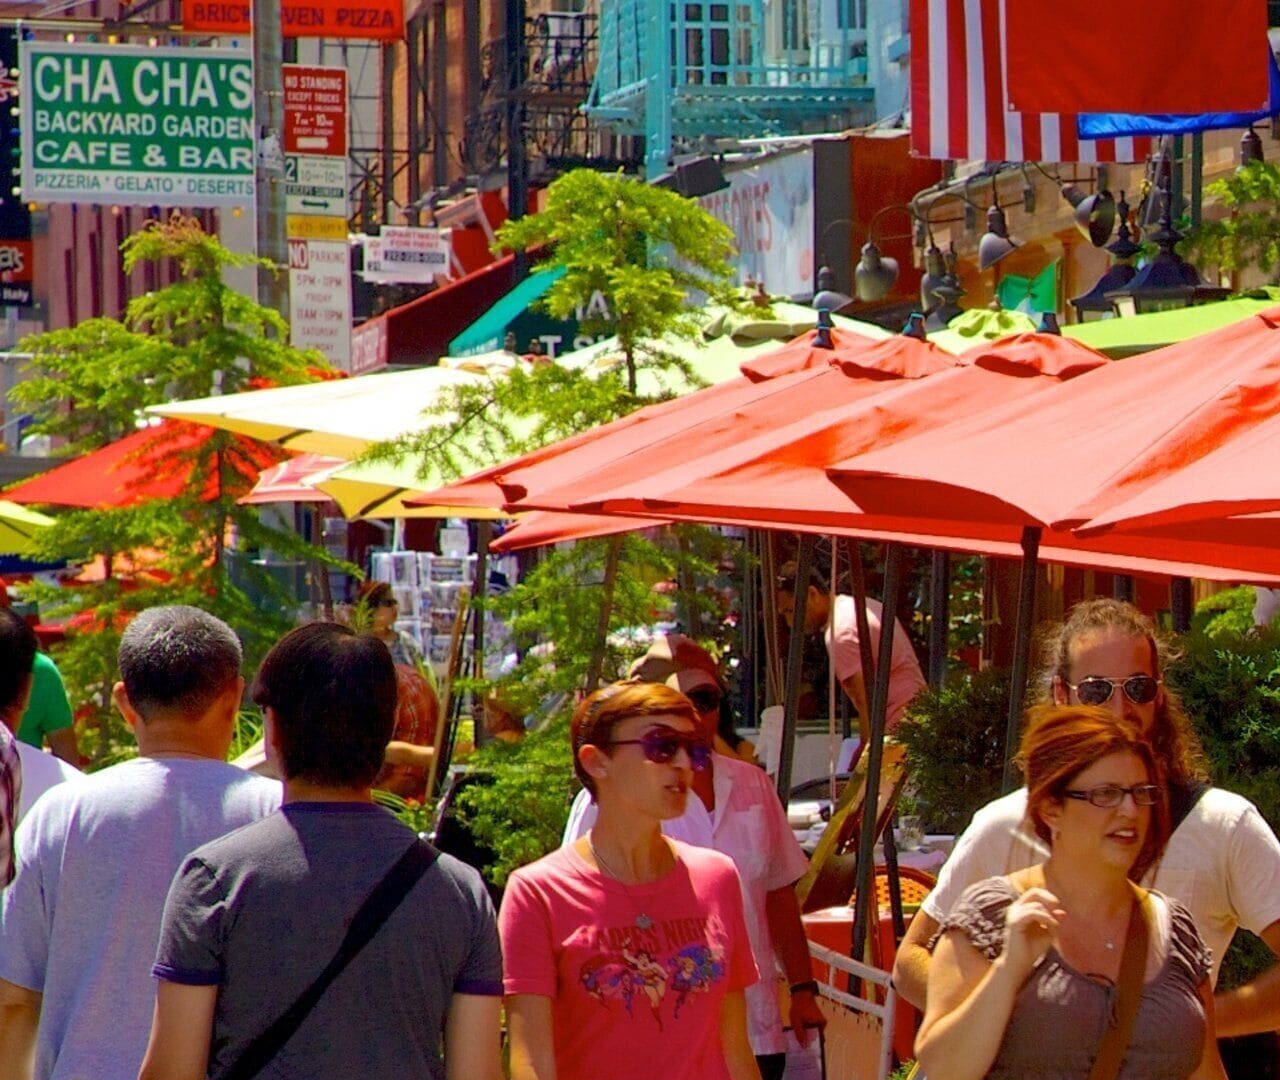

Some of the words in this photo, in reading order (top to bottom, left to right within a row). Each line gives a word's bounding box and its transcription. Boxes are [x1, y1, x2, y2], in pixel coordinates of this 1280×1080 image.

[283, 7, 324, 25] VEN
[336, 8, 393, 28] PIZZA
[35, 56, 121, 104] CHA
[133, 59, 252, 109] CHA'S
[285, 75, 299, 89] NO
[300, 76, 342, 90] STANDING
[287, 91, 312, 101] EXCEPT
[314, 92, 340, 103] TRUCKS
[36, 110, 156, 135] BACKYARD
[163, 115, 253, 140] GARDEN
[36, 140, 132, 165] CAFE
[143, 144, 167, 167] &
[179, 146, 253, 170] BAR
[35, 173, 100, 189] PIZZERIA
[115, 176, 173, 192] GELATO
[187, 178, 253, 194] DESERTS
[288, 243, 308, 269] NO
[310, 251, 345, 264] PARKING
